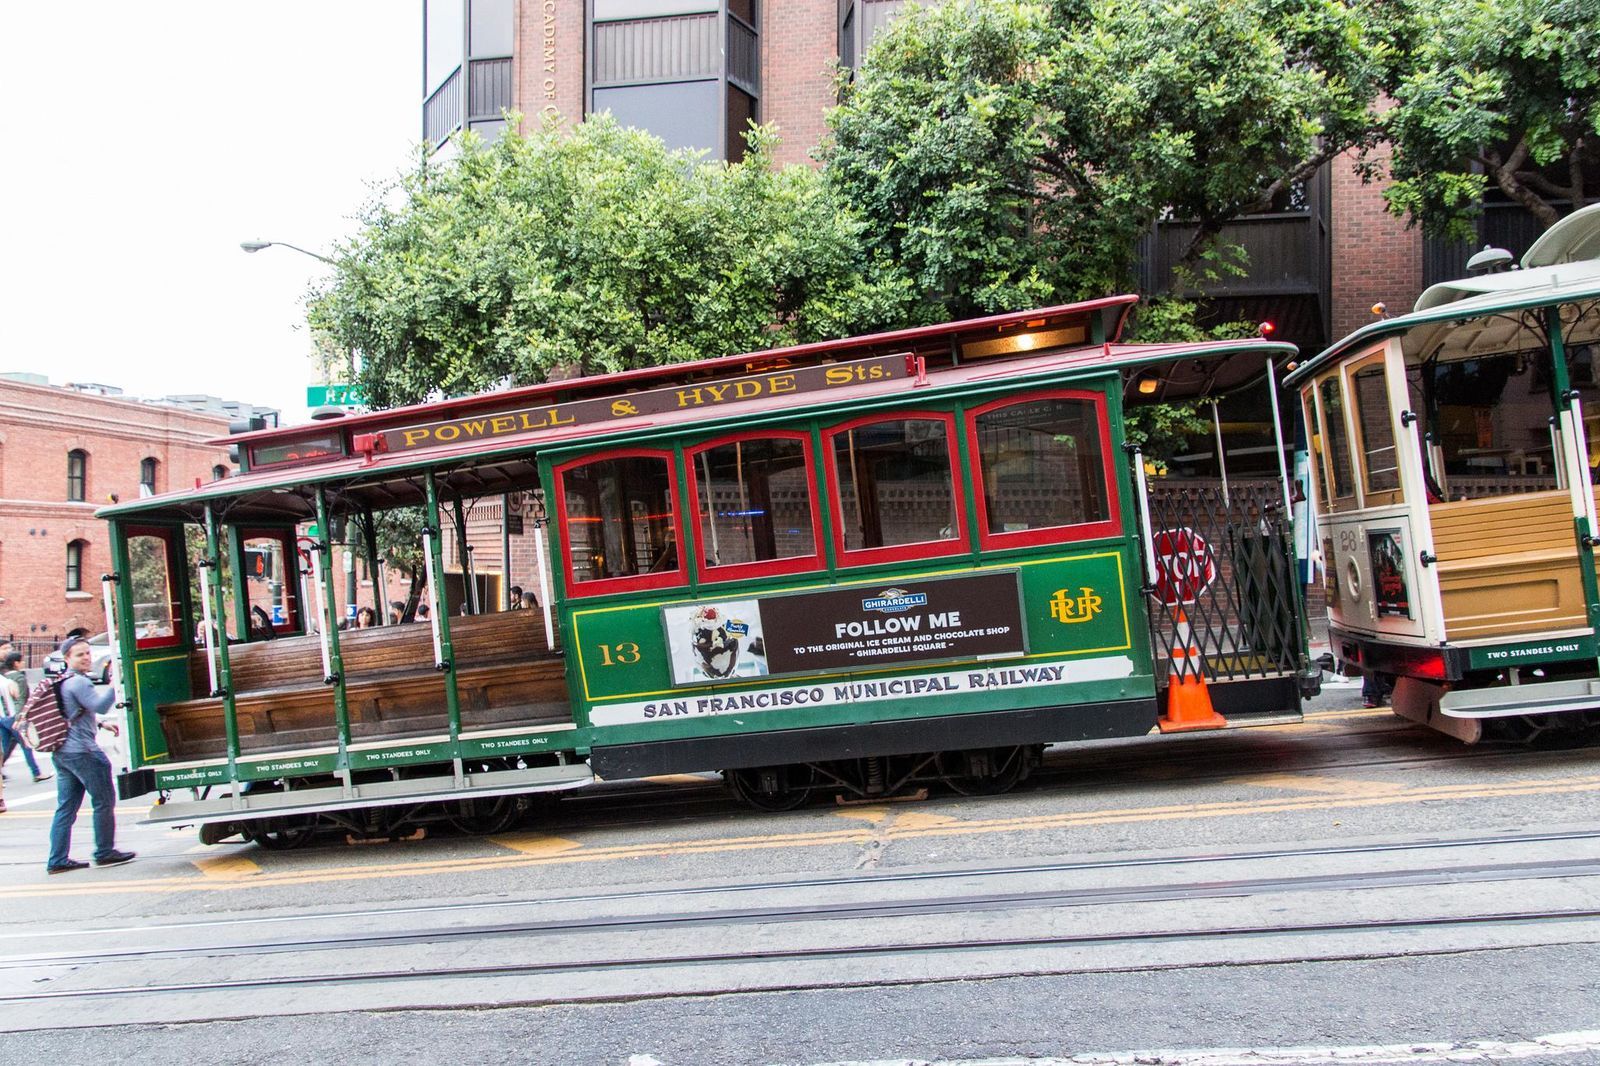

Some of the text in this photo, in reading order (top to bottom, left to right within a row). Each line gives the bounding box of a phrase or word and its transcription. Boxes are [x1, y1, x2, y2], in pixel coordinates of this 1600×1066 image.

[543, 0, 556, 74] CADEMY
[543, 78, 556, 101] OF
[404, 363, 893, 446] POWELL & HYDE Sts.
[865, 596, 925, 608] GHIRARDELLI
[835, 611, 961, 639] FOLLOW ME
[794, 626, 1010, 655] TO THE ORIGINAL ICE CREAM AND CHOCOLATE SHOP
[856, 642, 947, 657] GHIRARDELLI SQUARE
[598, 641, 642, 667] 13
[1487, 644, 1579, 659] TWO STANDEES ONLY
[643, 665, 1067, 719] SAN FRANCISCO MUNICIPAL RAILWAY
[496, 739, 530, 747] STANDEES
[381, 751, 413, 759] STANDEES
[271, 762, 302, 770] STANDEES
[176, 772, 206, 780] STANDEES
